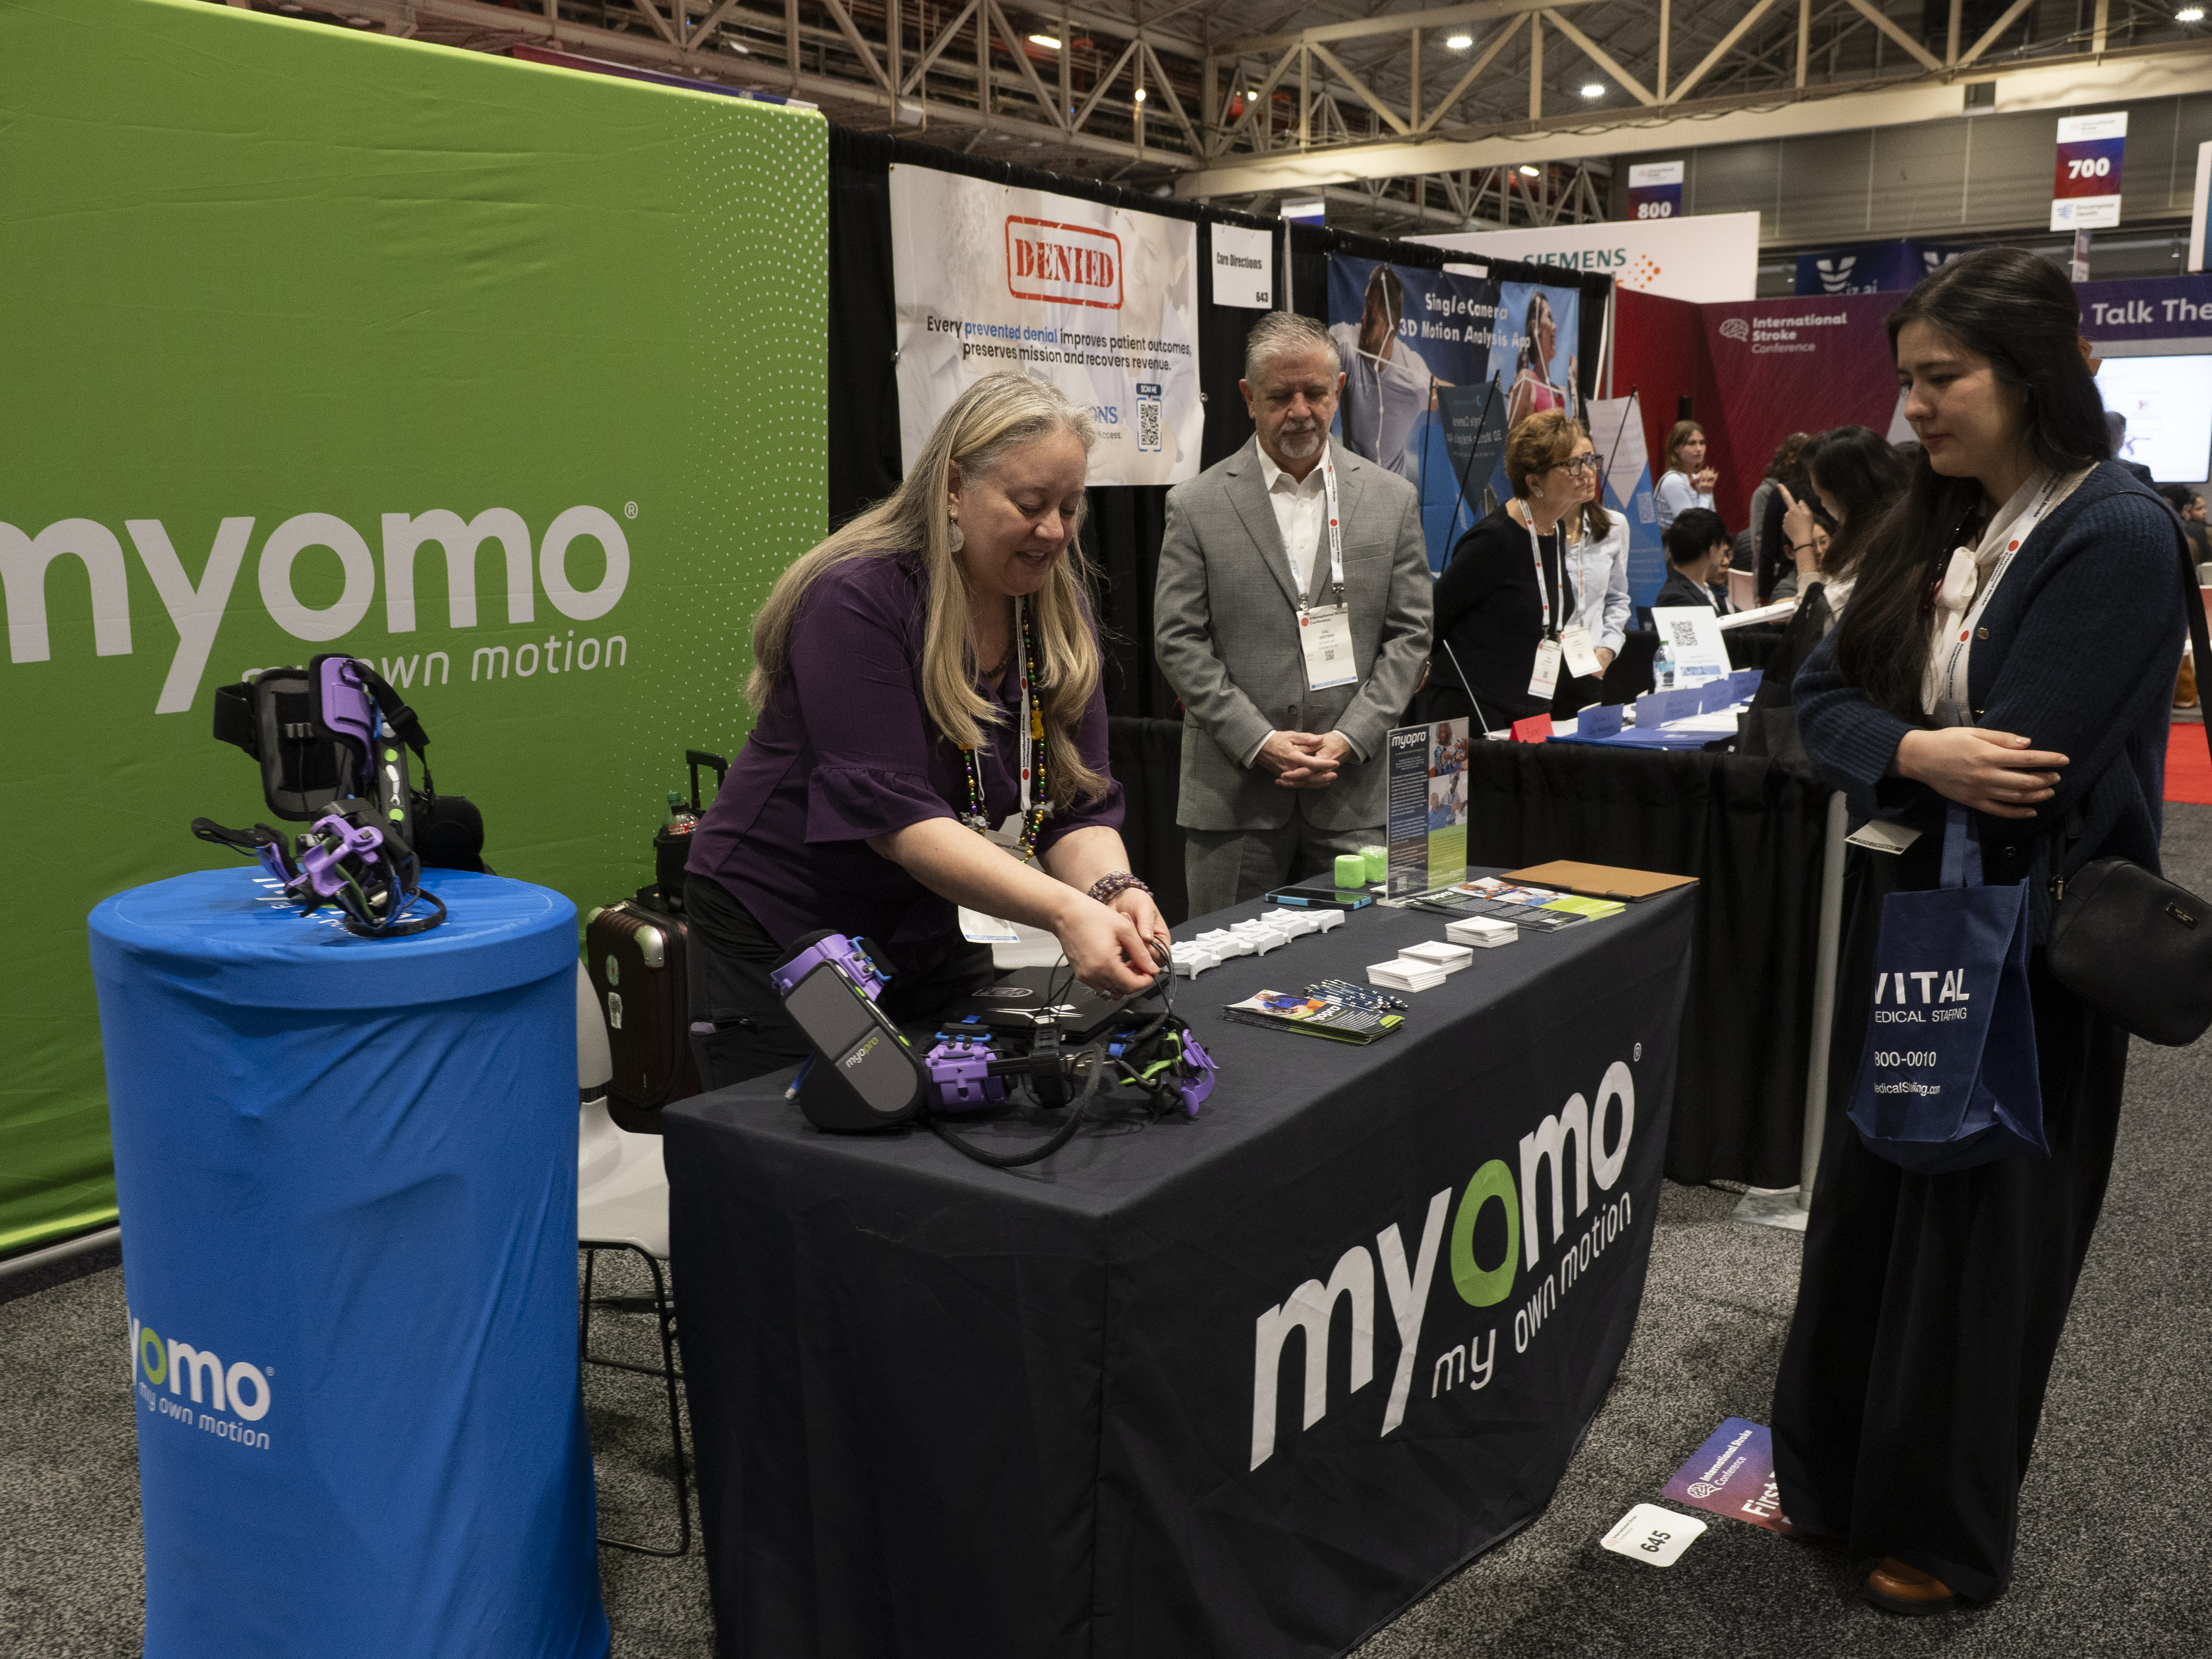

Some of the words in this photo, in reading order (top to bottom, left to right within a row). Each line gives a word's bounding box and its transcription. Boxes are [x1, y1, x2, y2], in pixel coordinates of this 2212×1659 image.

[2068, 157, 2110, 180] 700
[1637, 201, 1672, 219] 800
[1015, 238, 1115, 288] DENIED
[1217, 252, 1228, 266] Care
[1230, 254, 1263, 270] Directions
[1256, 291, 1269, 303] 643
[1425, 292, 1467, 317] Single
[1752, 311, 1848, 329] International
[2092, 300, 2154, 326] Talk
[927, 315, 962, 338] Every
[965, 322, 1022, 340] prevented
[1023, 326, 1058, 343] denial
[1060, 328, 1107, 349] improves
[1109, 335, 1146, 352] patient
[1148, 339, 1192, 357] outcomes,
[1399, 317, 1418, 337] 3D
[1421, 320, 1460, 341] Motion
[1464, 325, 1508, 349] Analysis
[1511, 332, 1531, 349] App
[1752, 328, 1797, 342] Stroke
[963, 342, 1017, 360] preserves
[1019, 345, 1062, 363] mission
[1064, 350, 1084, 364] and
[1086, 353, 1130, 368] recovers
[1132, 355, 1172, 371] revenue.
[1751, 343, 1816, 354] Conference
[1140, 384, 1151, 393] SCAN
[1991, 552, 2009, 582] Conference
[1991, 553, 2013, 588] International
[1981, 589, 1993, 606] Stroke
[471, 630, 627, 682] motion
[1947, 642, 1960, 673] Conference
[1950, 643, 1964, 681] International
[1391, 731, 1426, 749] myopro
[1874, 968, 1970, 1004] VITAL
[1303, 1005, 1341, 1022] myopro
[846, 1037, 879, 1068] myopro
[1249, 1060, 1635, 1473] myomo
[1431, 1328, 1496, 1399] my
[1514, 1274, 1555, 1353] own
[1561, 1191, 1631, 1295] motion
[139, 1381, 156, 1412] my
[159, 1397, 193, 1426] own
[198, 1414, 270, 1451] motion
[1699, 1445, 1738, 1481] International
[1730, 1429, 1753, 1447] Stroke
[1714, 1456, 1747, 1486] Conference
[1741, 1482, 1780, 1518] First
[1640, 1530, 1671, 1553] 645
